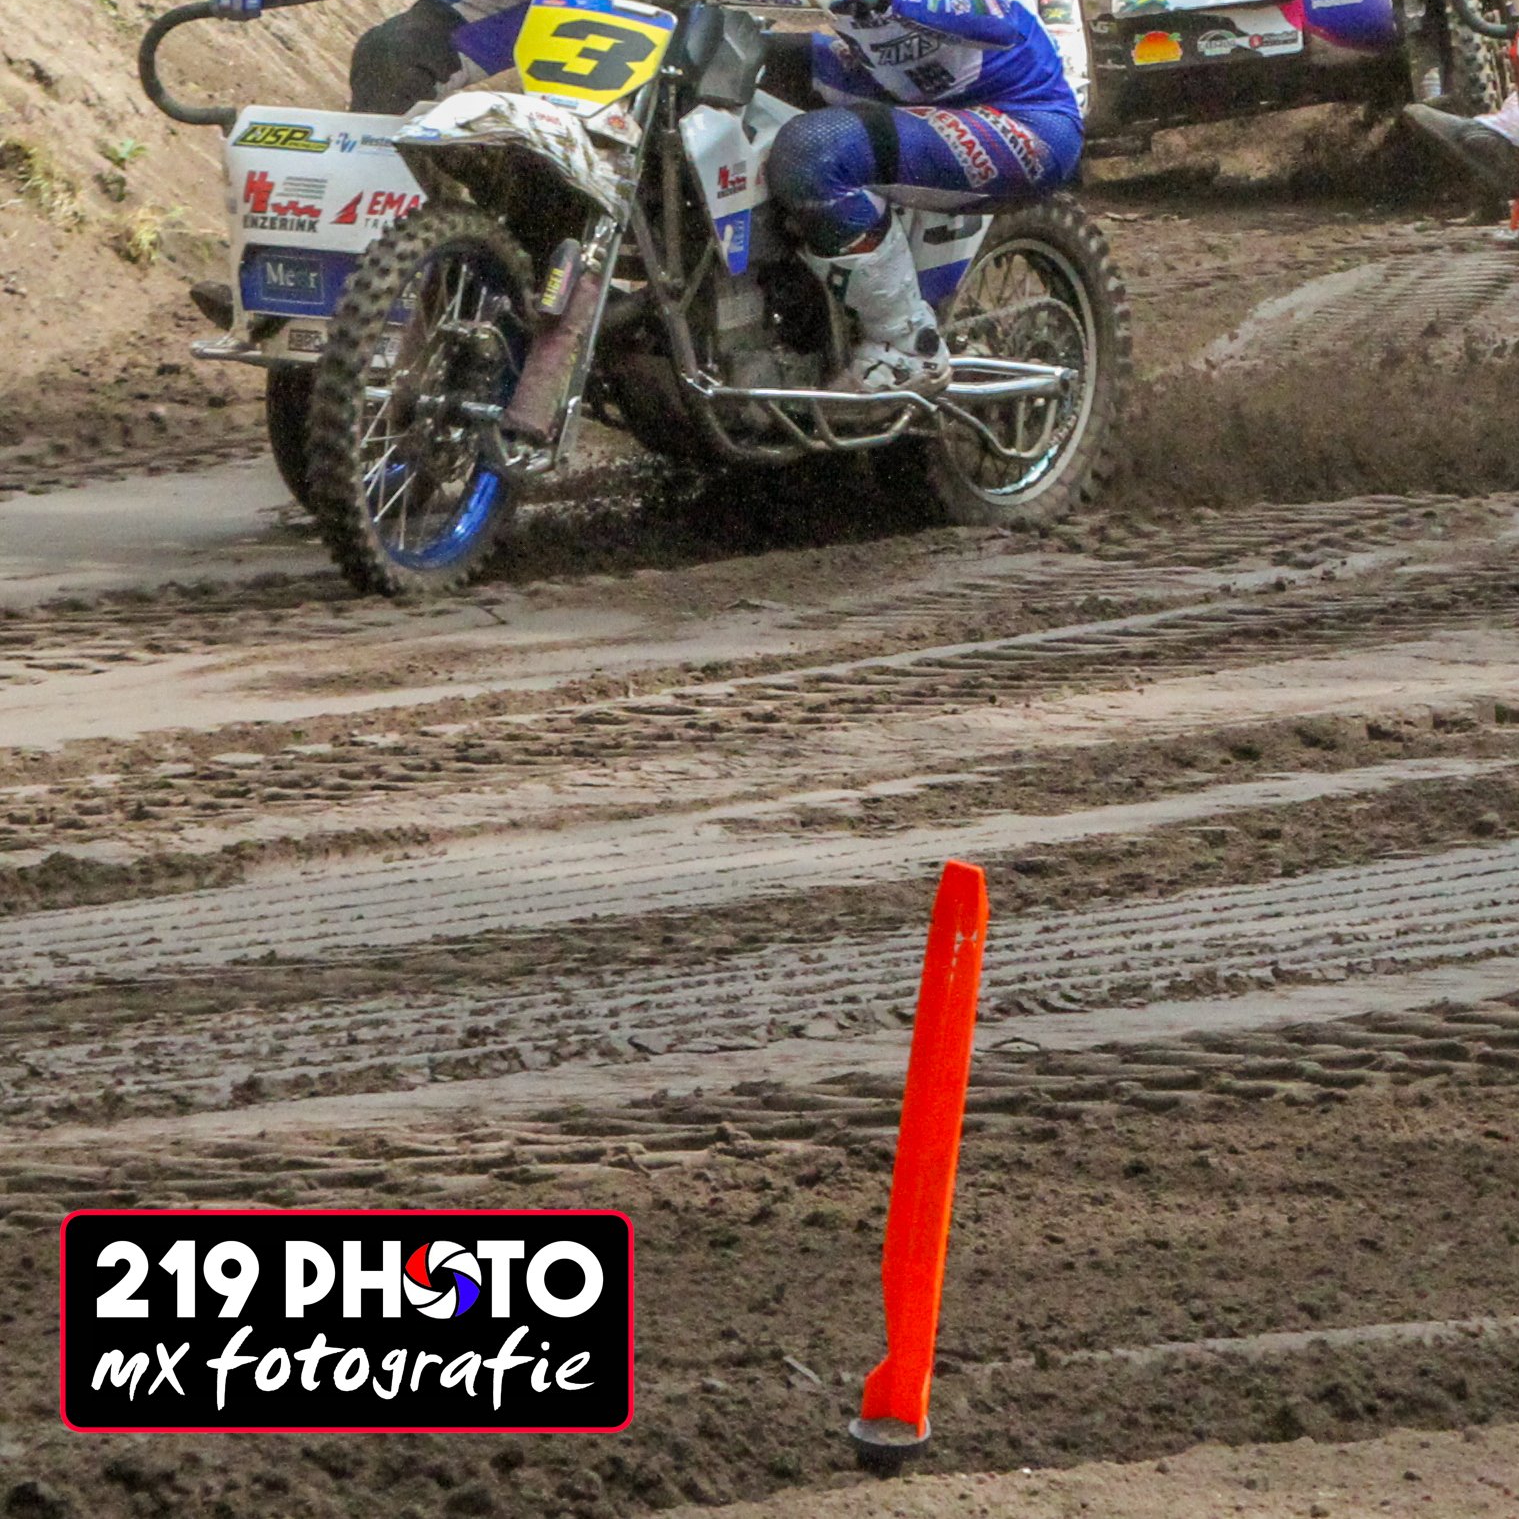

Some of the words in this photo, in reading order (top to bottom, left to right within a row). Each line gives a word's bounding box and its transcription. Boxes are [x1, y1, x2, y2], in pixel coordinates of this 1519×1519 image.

[526, 19, 658, 91] 3
[367, 190, 422, 221] EMA
[242, 215, 321, 234] ENZERINK
